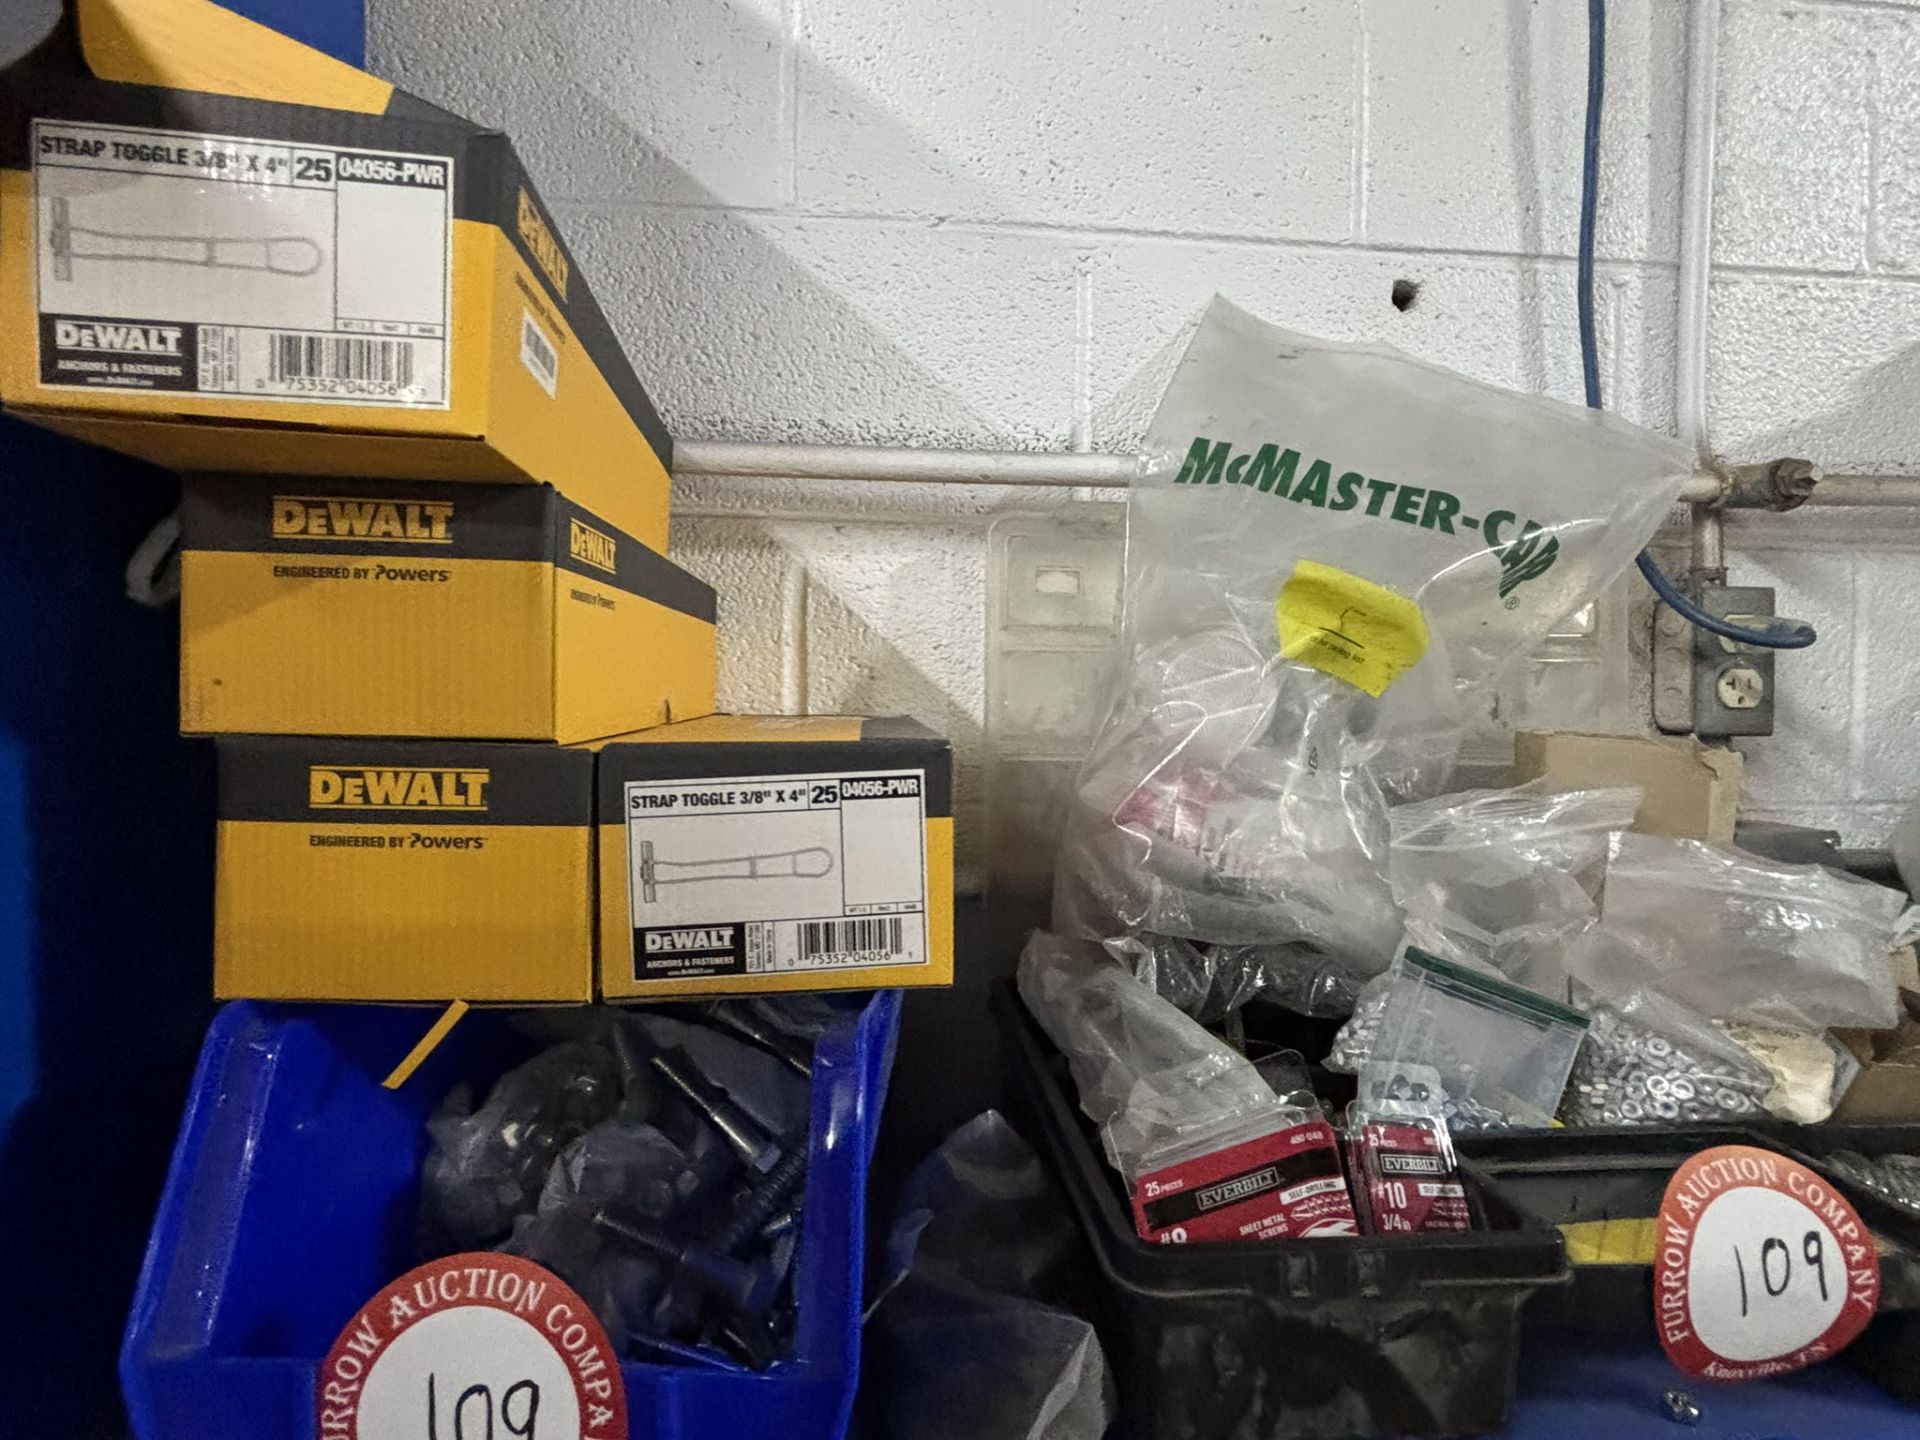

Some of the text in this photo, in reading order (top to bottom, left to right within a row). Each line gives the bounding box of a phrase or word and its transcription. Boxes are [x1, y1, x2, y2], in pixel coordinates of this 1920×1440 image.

[39, 136, 288, 173] STRAP TOGGLE 3/8" X 4"
[295, 156, 332, 182] 25
[338, 157, 445, 186] 04056-PWR
[286, 376, 338, 394] 75352
[273, 563, 449, 582] ENGINEERED BY Powers
[811, 785, 838, 804] 25
[842, 779, 919, 797] 04056-PWR
[631, 788, 806, 809] STRAP TOGGLE 3/8" X 4"
[309, 833, 484, 849] ENGINEERED BY Powers
[646, 956, 735, 969] ANCHORS & FASTENERS
[788, 958, 794, 967] 0
[811, 952, 848, 965] 75352
[853, 950, 891, 962] 04056
[1368, 1133, 1379, 1147] 25
[1384, 1157, 1438, 1171] EVERBILT
[1145, 1181, 1161, 1197] 25
[1200, 1171, 1275, 1206] EVERBILT
[1377, 1182, 1408, 1209] #10
[1239, 1221, 1263, 1236] SHEET
[1258, 1223, 1289, 1239] SCREWS
[1662, 1157, 1876, 1344] FURROW AUCTION COMPANY
[1733, 1230, 1828, 1318] 109
[321, 1267, 616, 1440] RROW AUCTION COMPA
[427, 1371, 540, 1440] 109
